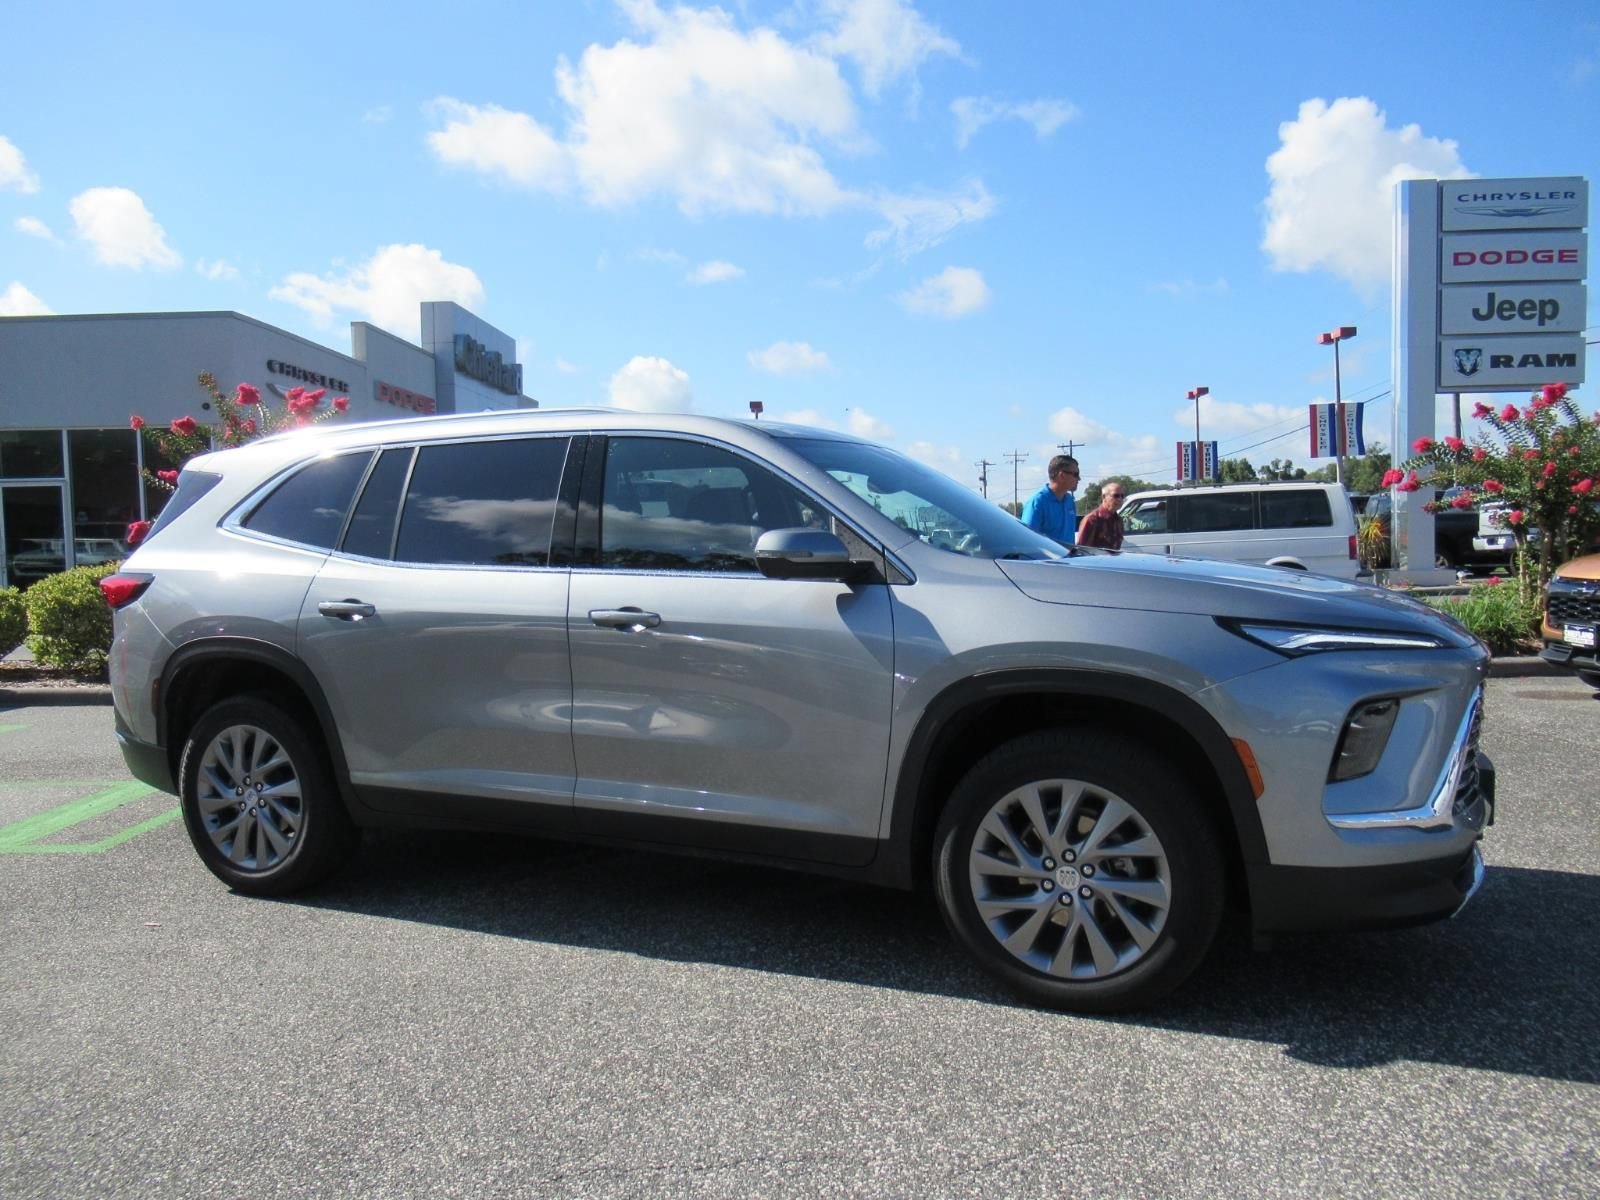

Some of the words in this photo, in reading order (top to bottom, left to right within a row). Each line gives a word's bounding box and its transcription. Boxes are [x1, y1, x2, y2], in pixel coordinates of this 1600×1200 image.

[1457, 190, 1577, 203] CHRYSLER
[1453, 248, 1579, 267] DODGE
[1472, 292, 1560, 326] Jeep
[1490, 352, 1577, 369] RAM
